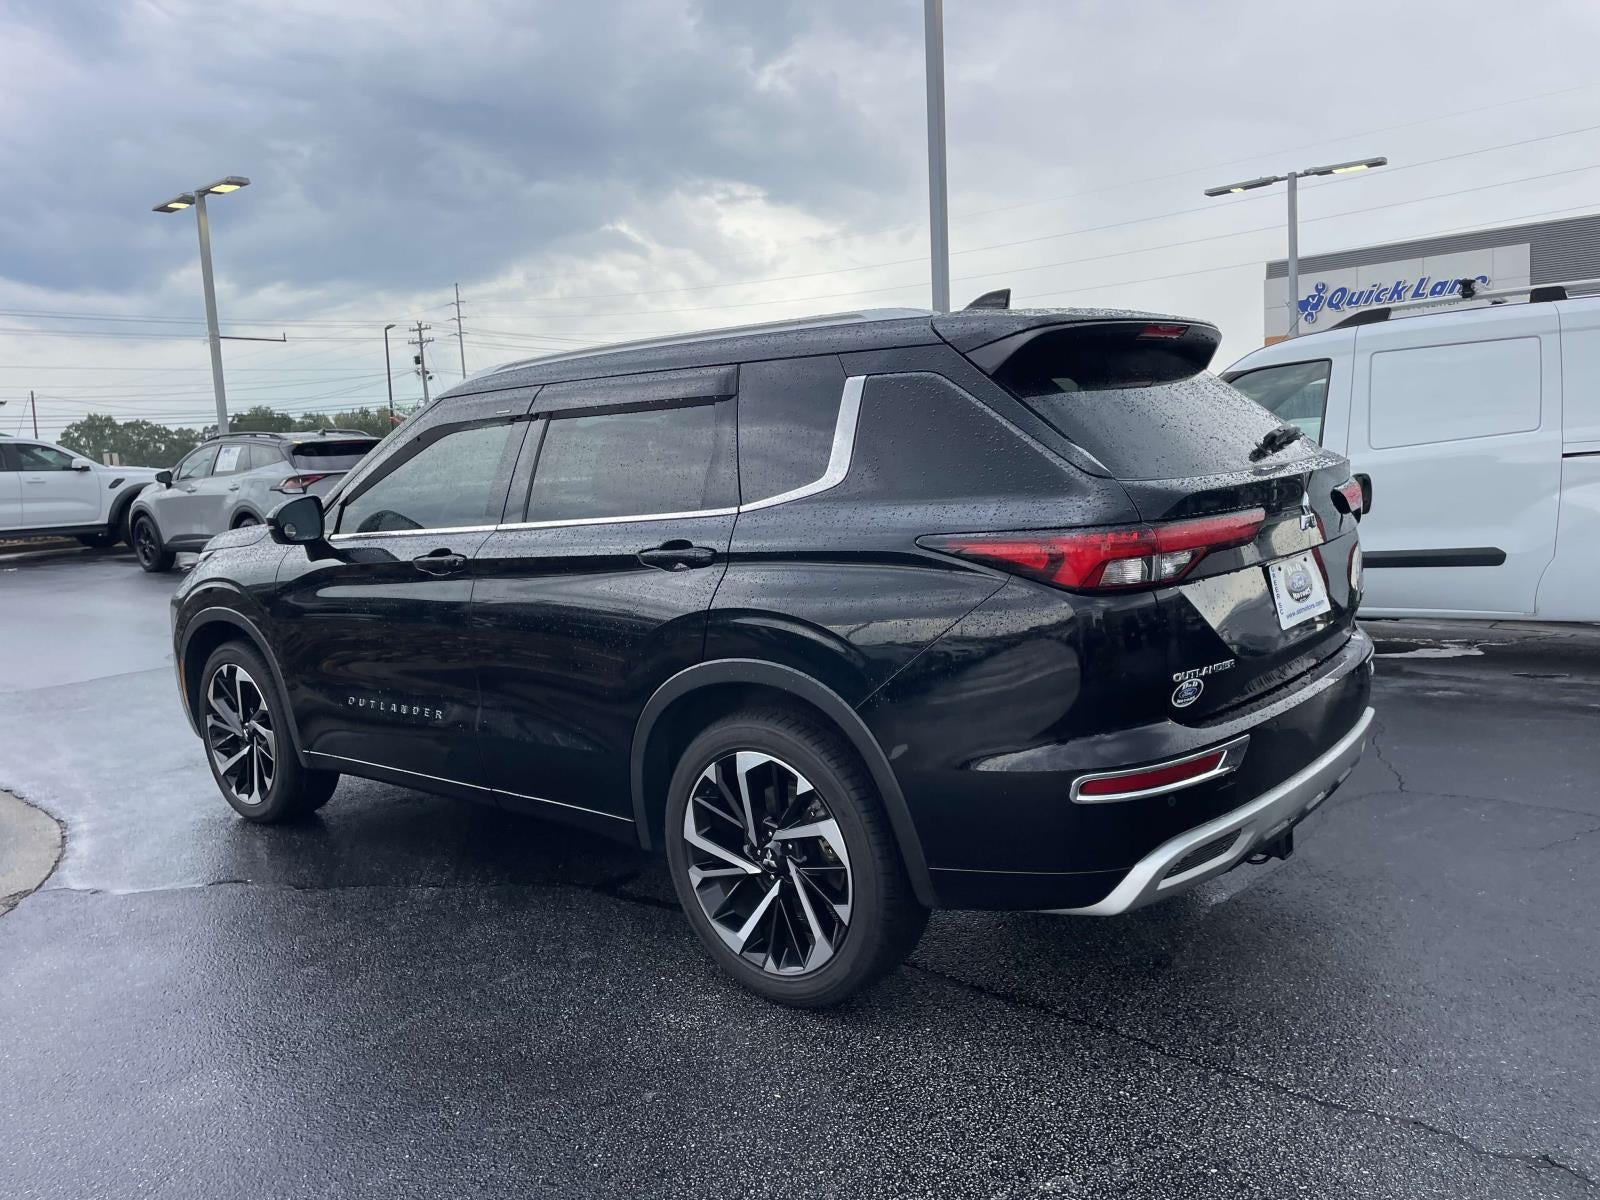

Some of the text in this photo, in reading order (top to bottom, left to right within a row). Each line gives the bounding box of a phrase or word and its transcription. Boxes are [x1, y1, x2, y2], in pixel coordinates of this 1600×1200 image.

[1327, 280, 1409, 311] Quick
[1172, 658, 1236, 682] OUTLANDER
[347, 696, 443, 719] OUTLANDER
